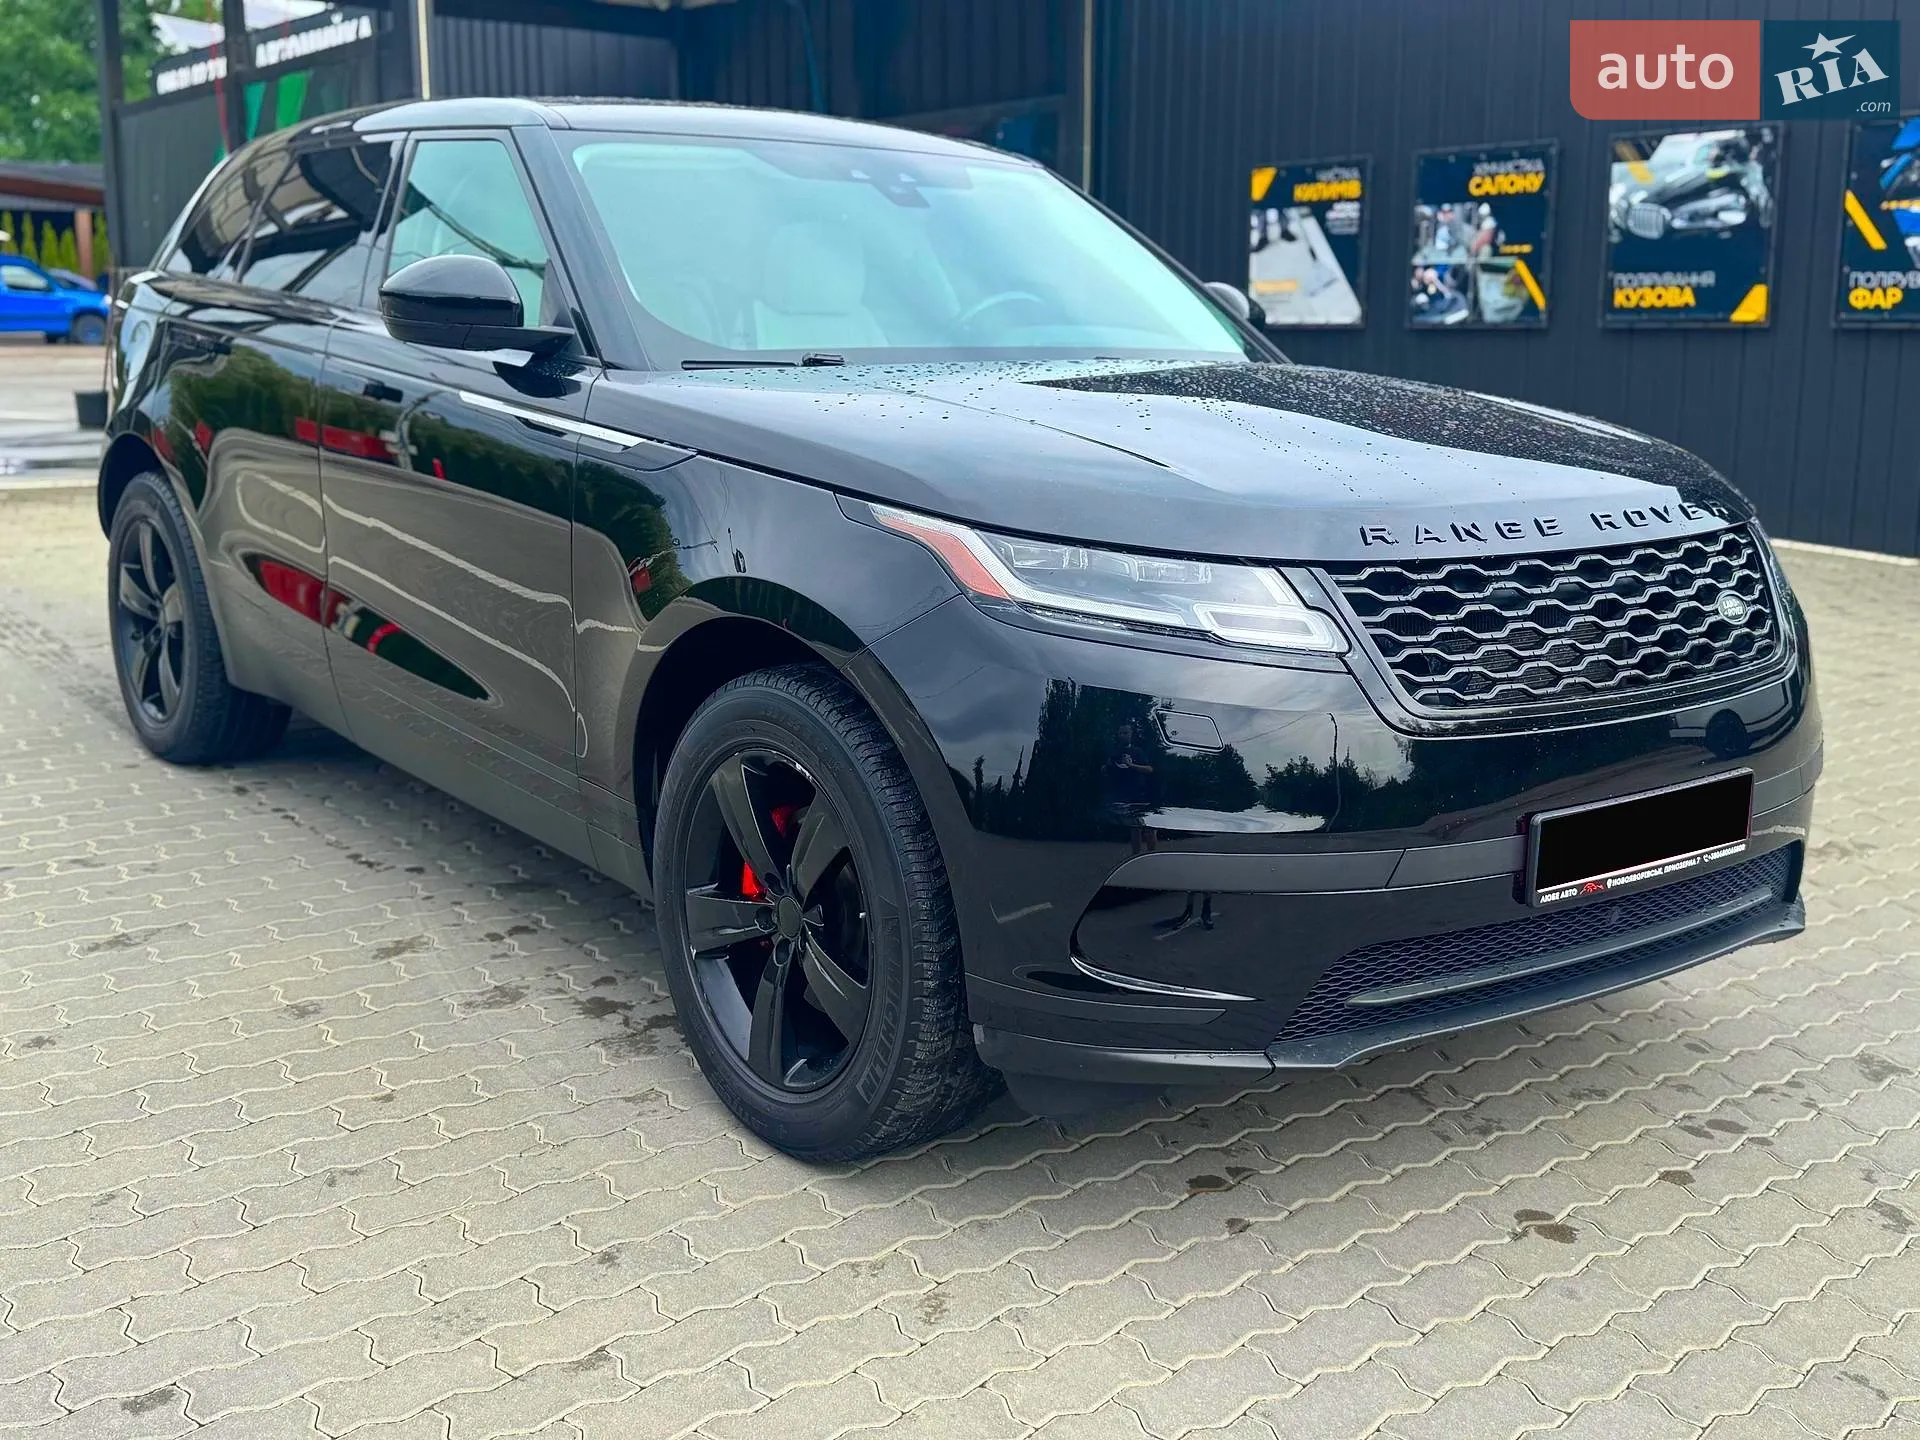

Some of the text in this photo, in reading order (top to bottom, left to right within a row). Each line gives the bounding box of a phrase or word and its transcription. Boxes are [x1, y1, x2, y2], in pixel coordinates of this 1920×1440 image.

[1468, 171, 1546, 197] САЛОНУ
[1613, 285, 1696, 309] КУЗОВА
[1848, 286, 1904, 310] ФАР
[1359, 499, 1730, 547] RANGE ROVER
